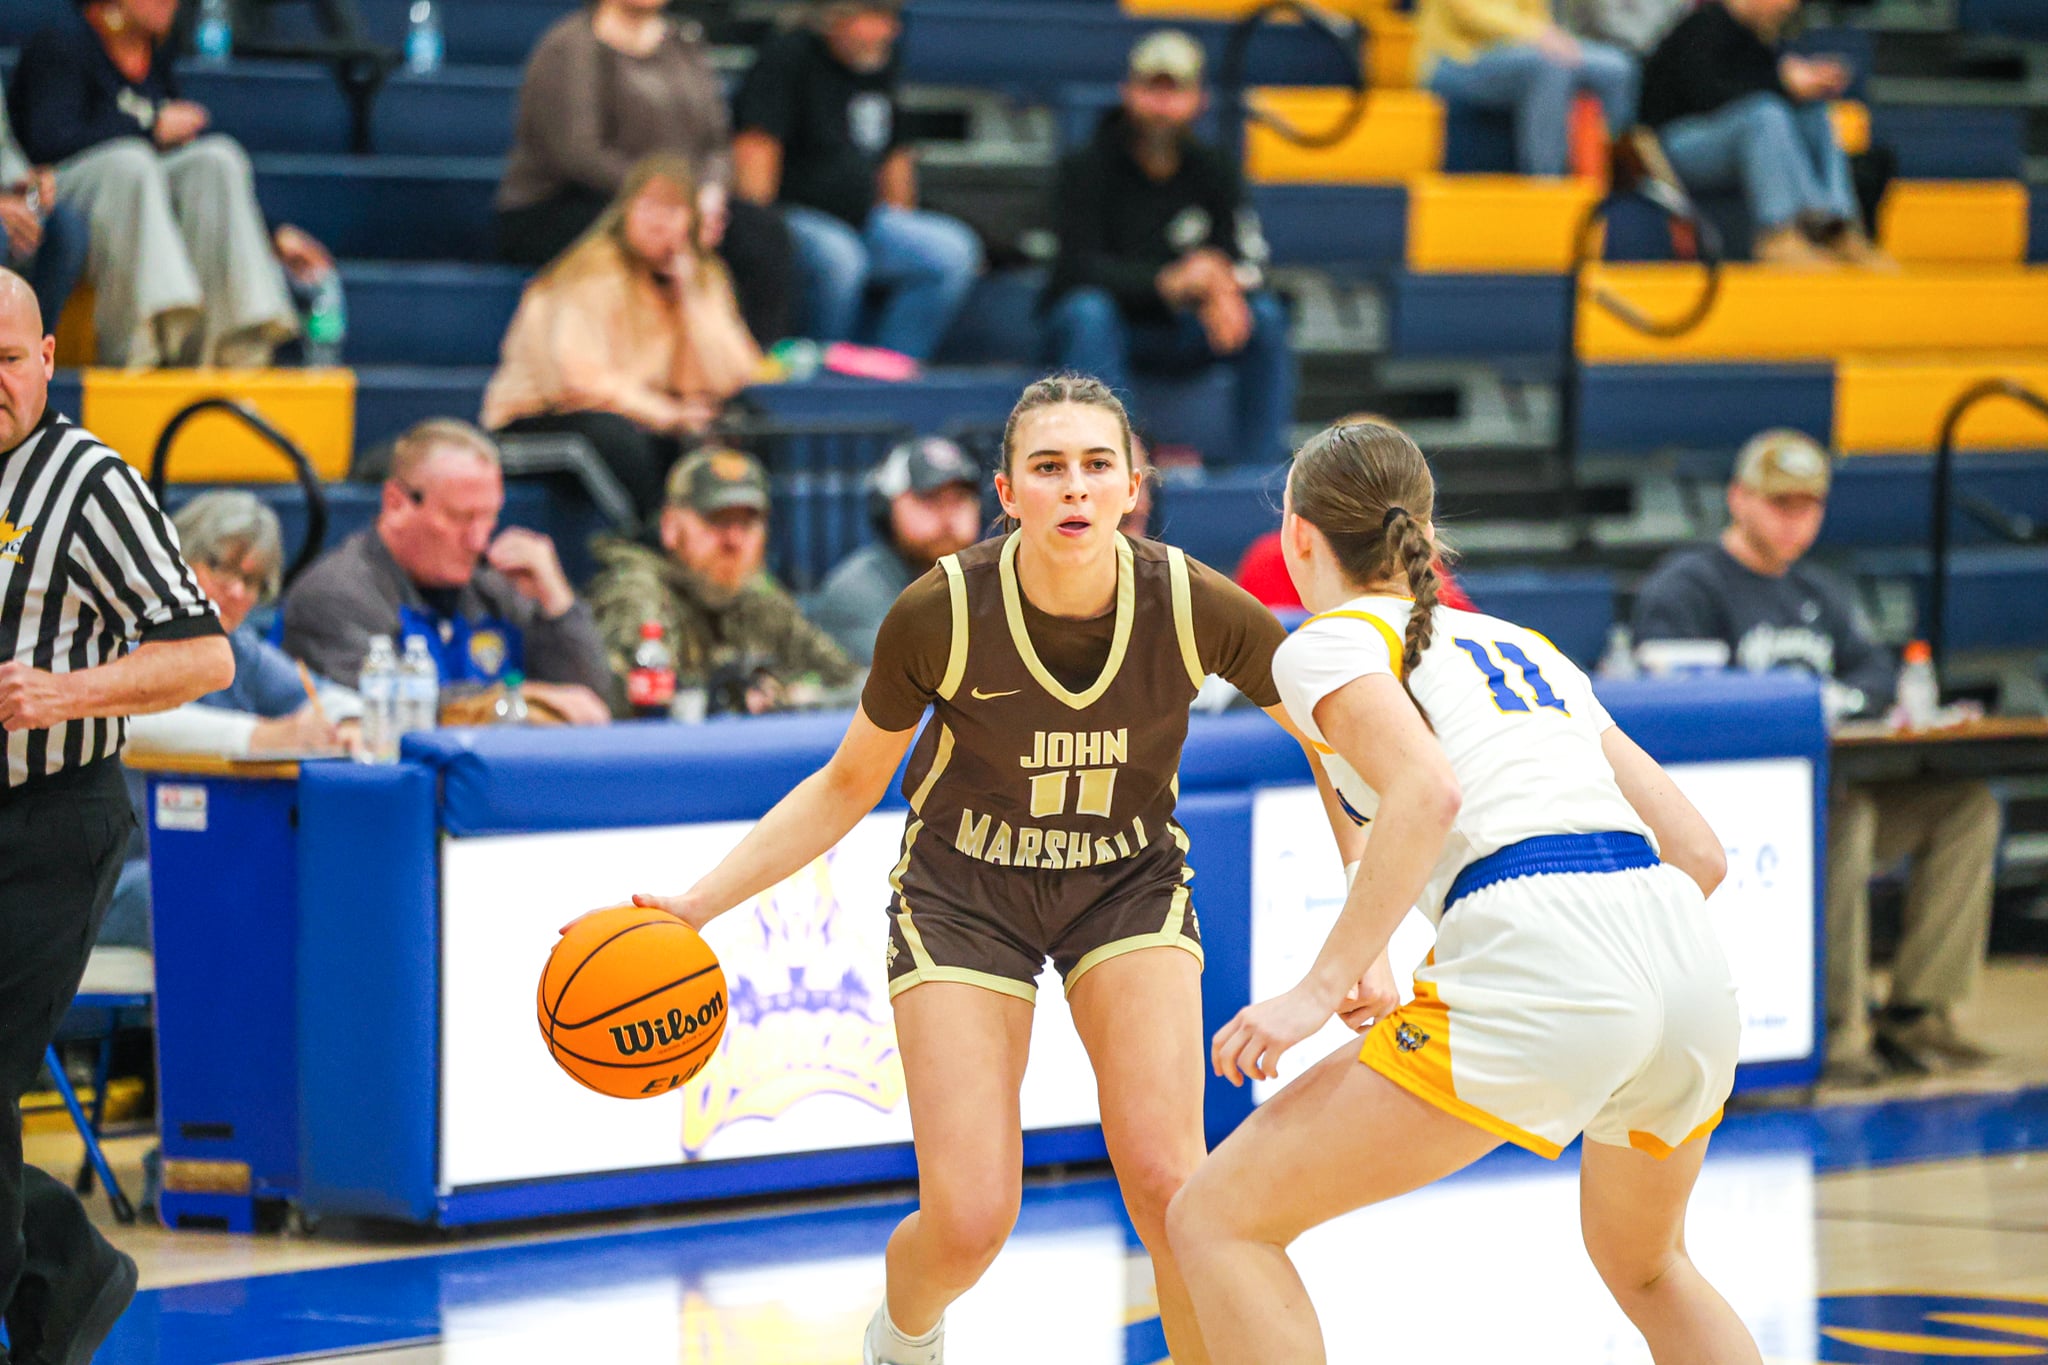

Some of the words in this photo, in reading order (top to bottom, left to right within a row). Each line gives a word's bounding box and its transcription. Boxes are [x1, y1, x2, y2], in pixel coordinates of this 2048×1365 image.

[1451, 636, 1571, 718] 11
[1020, 728, 1128, 768] JOHN
[1028, 768, 1118, 818] 11
[609, 990, 724, 1056] Wilson
